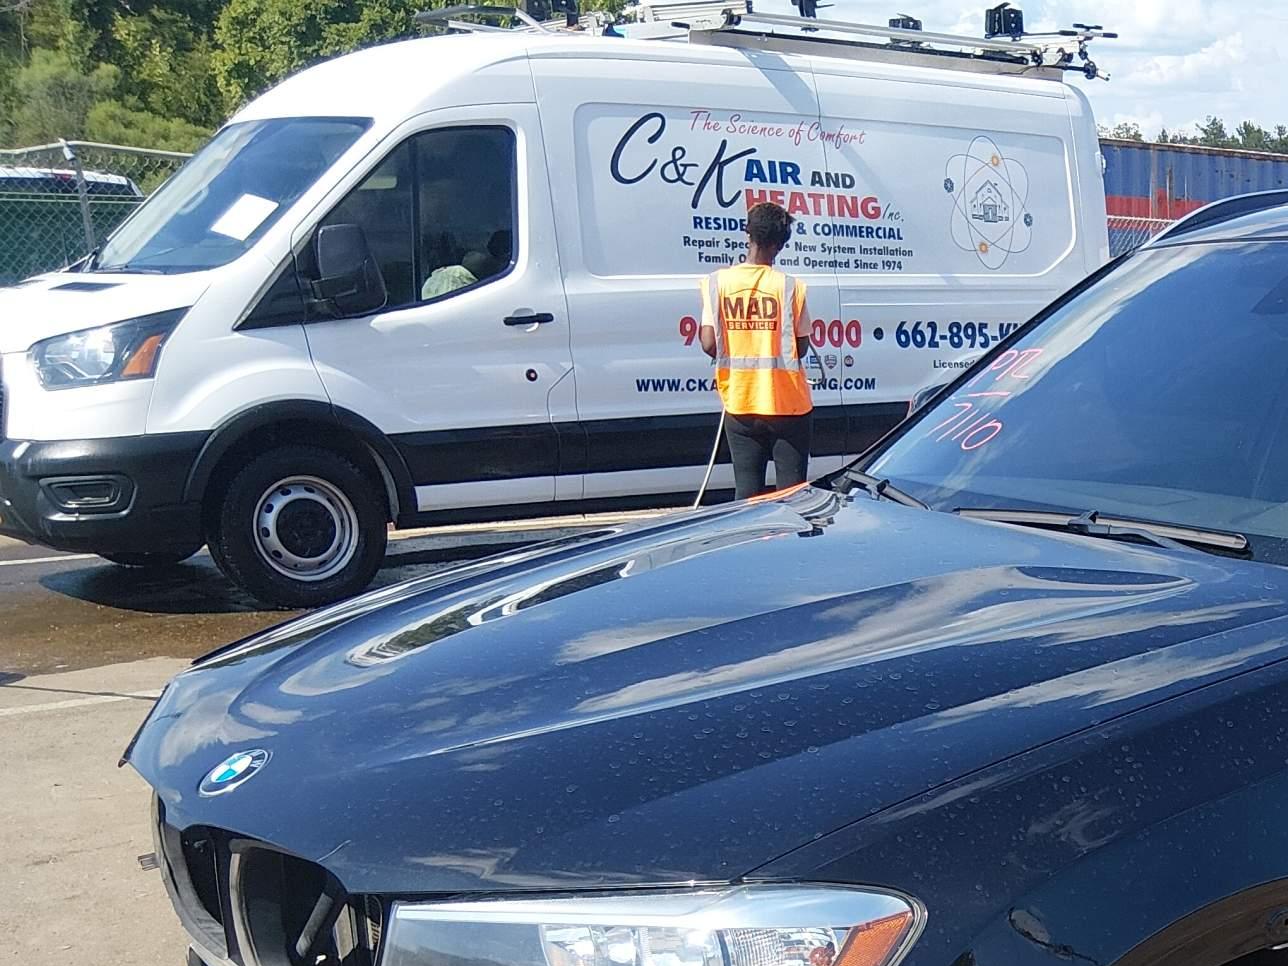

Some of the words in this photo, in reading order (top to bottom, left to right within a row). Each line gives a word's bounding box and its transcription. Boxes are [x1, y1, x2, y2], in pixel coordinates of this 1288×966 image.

[690, 110, 721, 132] The
[726, 113, 784, 137] Science
[788, 120, 805, 146] of
[807, 121, 867, 149] Comfort
[744, 158, 802, 186] AIR
[810, 170, 856, 189] AND
[744, 188, 882, 220] HEATING
[882, 203, 905, 222] Inc.
[796, 221, 807, 235] &
[813, 222, 904, 240] COMMERCIAL
[683, 235, 720, 250] Repair
[794, 241, 817, 252] New
[820, 242, 856, 255] System
[859, 244, 914, 257] Installation
[698, 251, 735, 266] Family
[779, 256, 800, 266] and
[803, 256, 850, 269] Operated
[854, 258, 879, 270] Since
[881, 259, 903, 271] 1974
[723, 296, 778, 320] MAD
